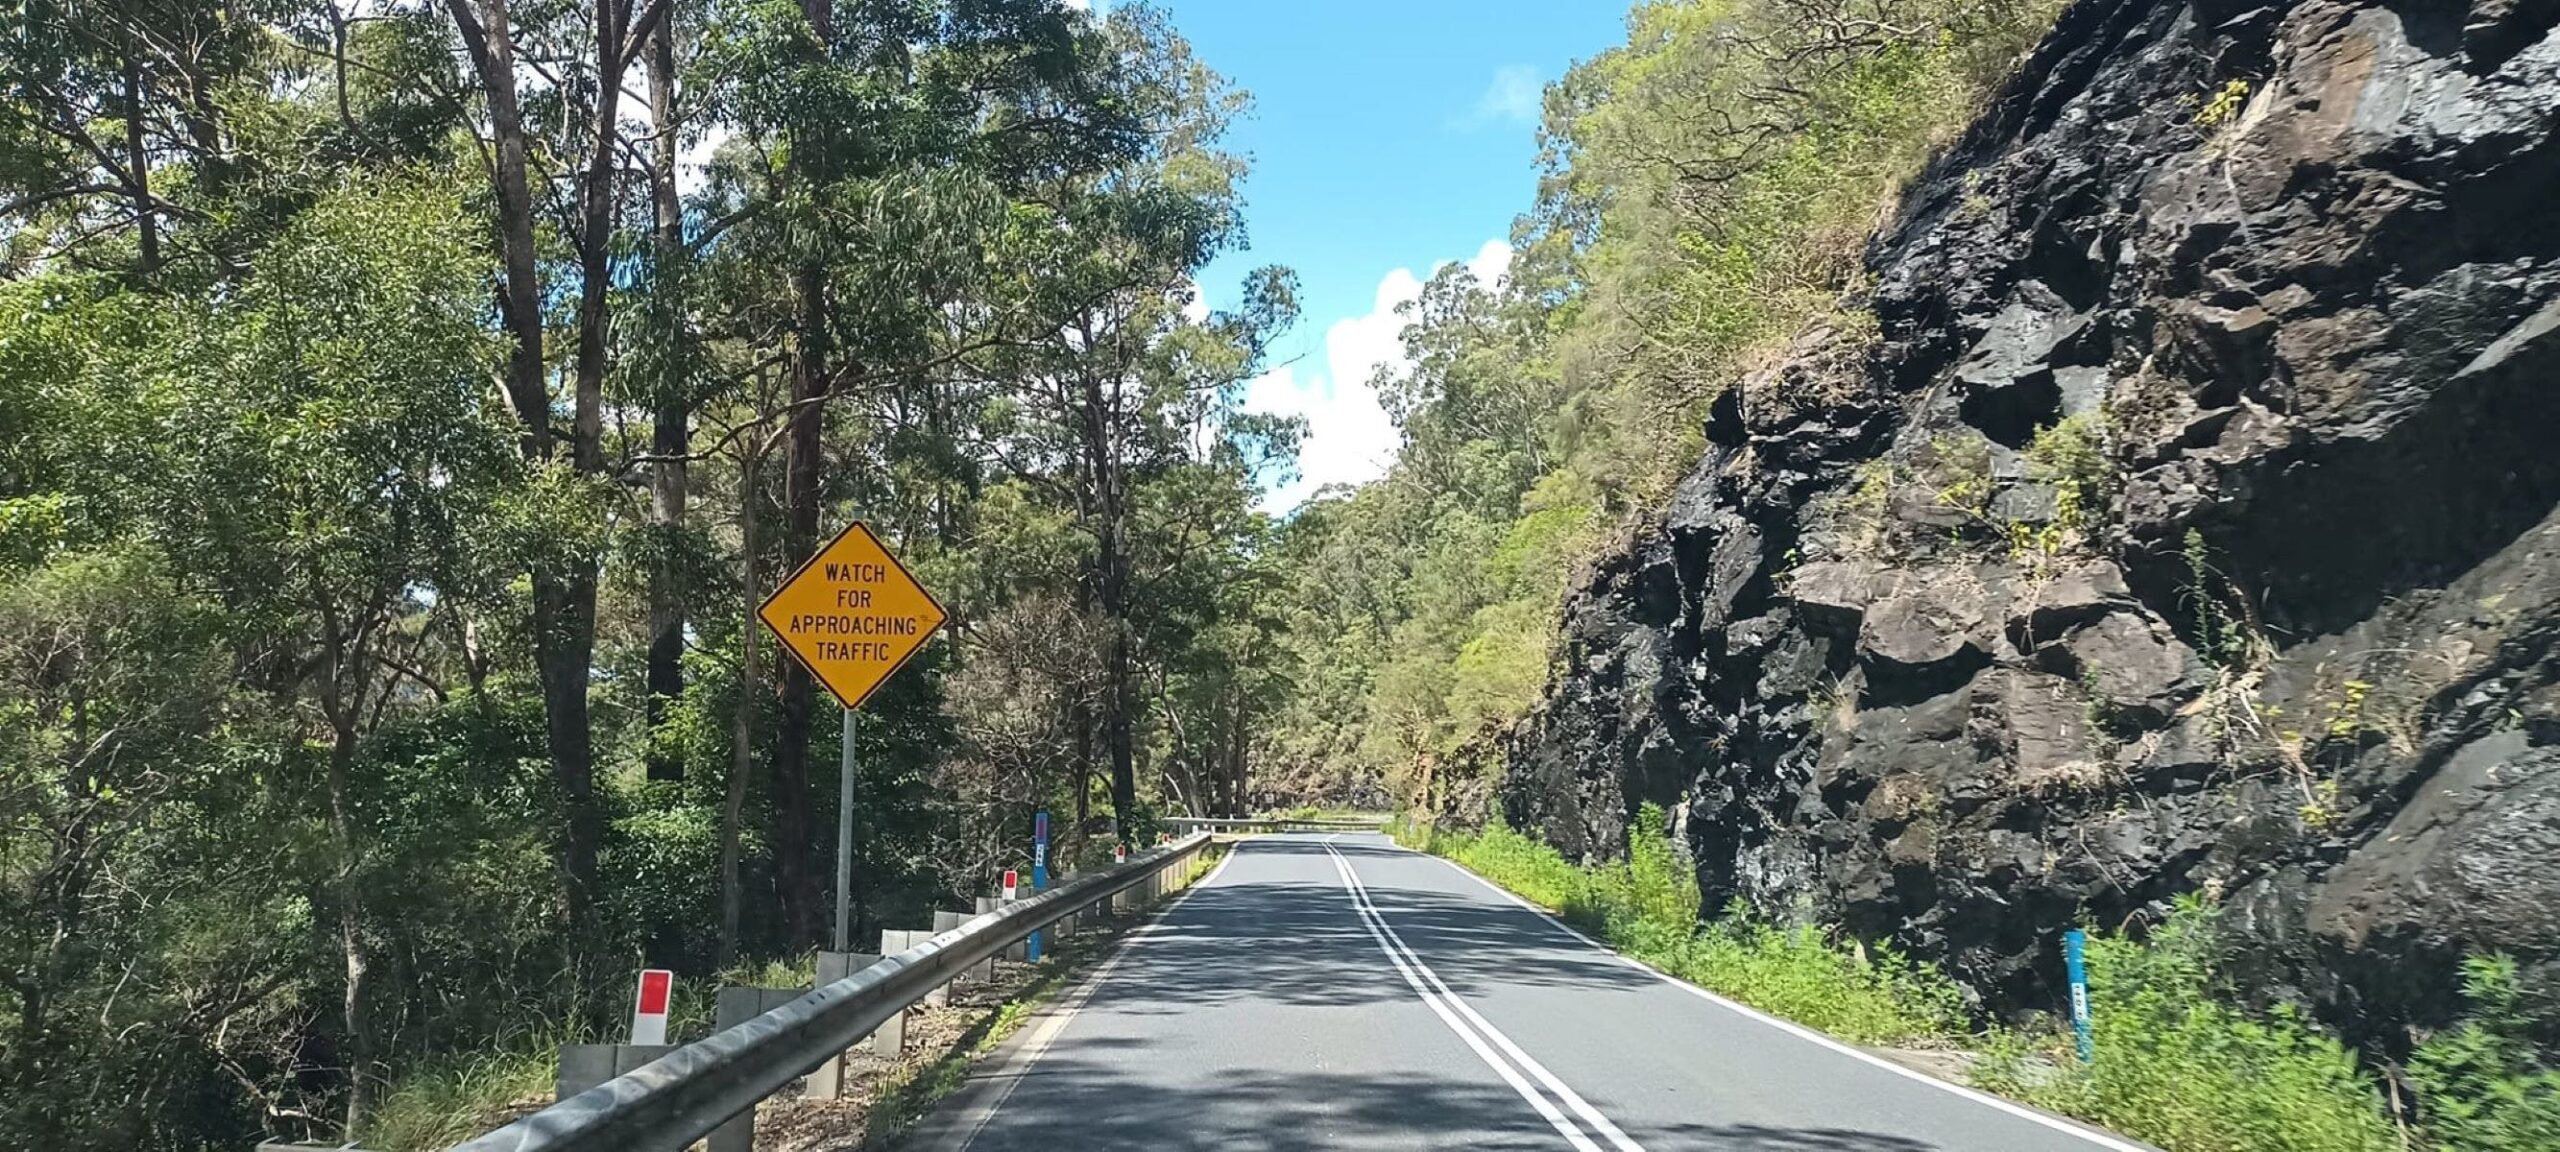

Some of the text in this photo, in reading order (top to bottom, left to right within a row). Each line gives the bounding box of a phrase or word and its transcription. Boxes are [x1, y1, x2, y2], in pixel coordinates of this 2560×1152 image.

[825, 564, 885, 583] WATCH
[837, 589, 871, 608] FOR
[789, 614, 916, 635] APPROACHING
[816, 642, 889, 661] TRAFFIC
